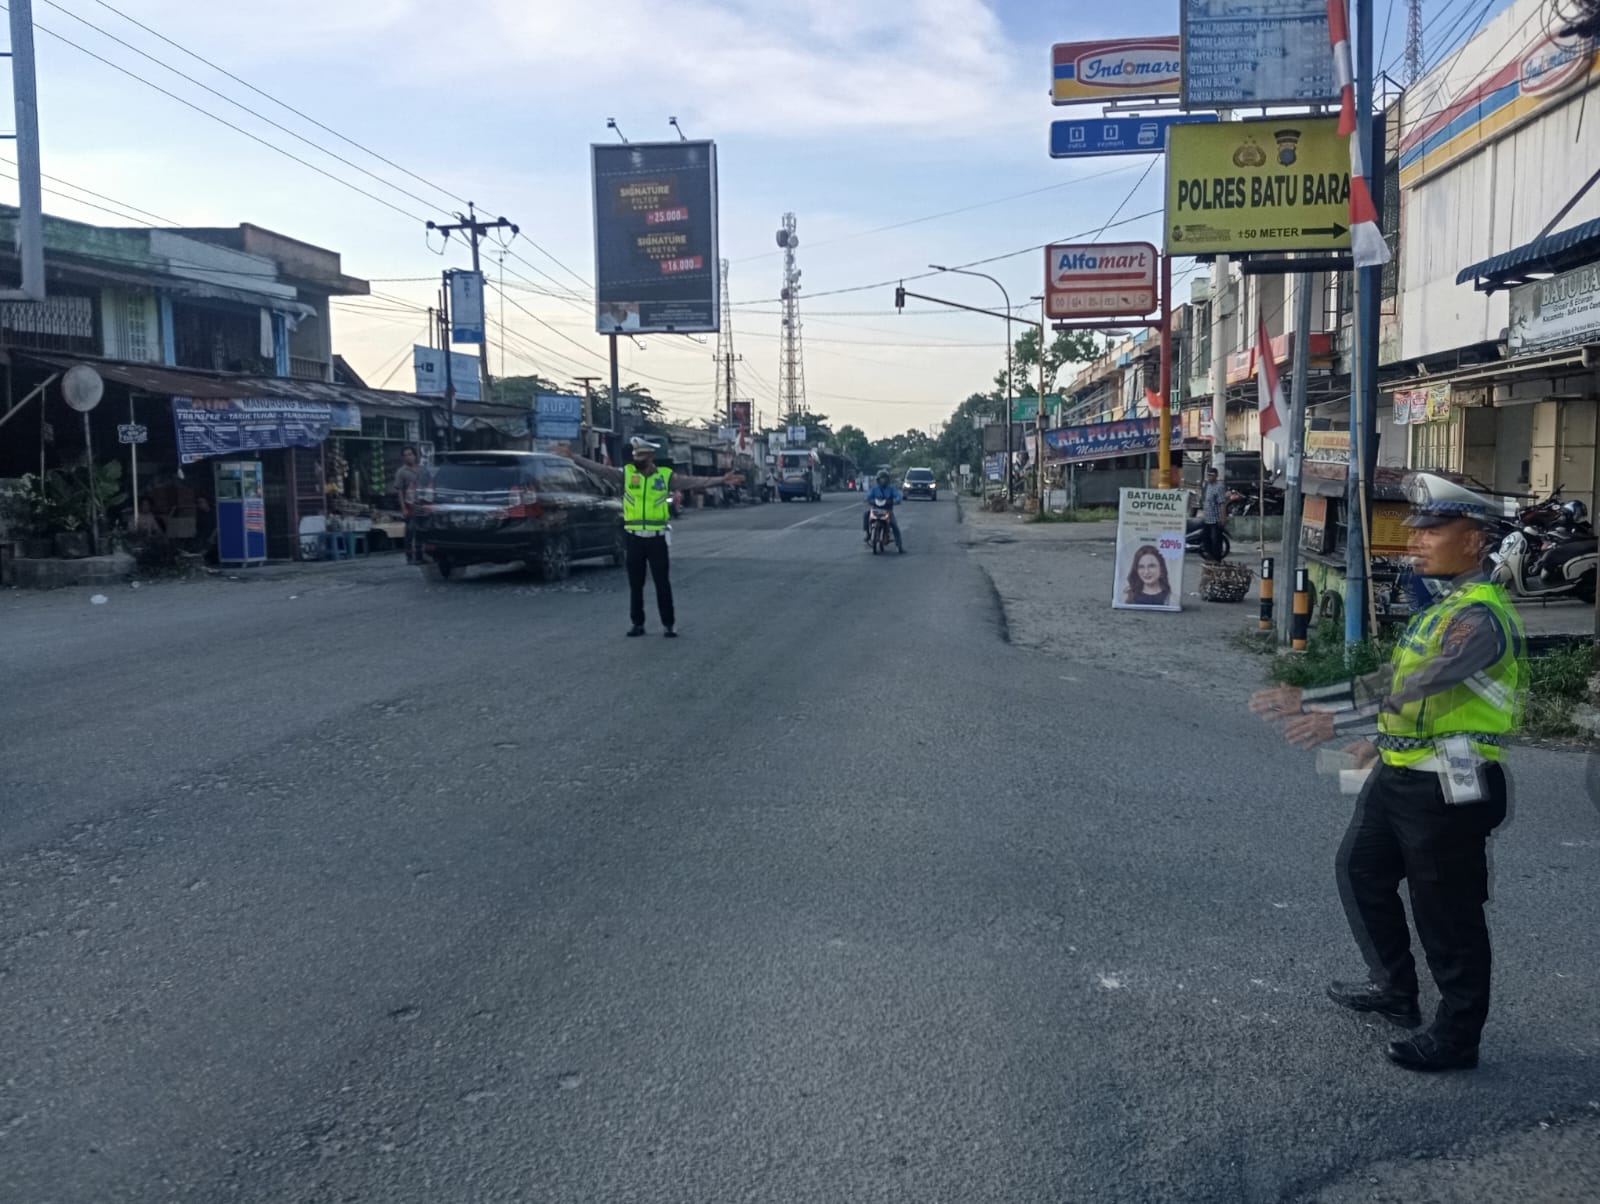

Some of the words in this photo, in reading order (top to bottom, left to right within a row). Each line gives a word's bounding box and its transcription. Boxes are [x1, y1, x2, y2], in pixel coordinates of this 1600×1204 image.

[1085, 58, 1179, 79] Indomare
[620, 184, 669, 197] SIGNATURE
[1178, 176, 1246, 211] POLRES
[1251, 174, 1298, 207] BATU
[1302, 172, 1350, 205] BARA
[1260, 228, 1299, 238] METER
[637, 235, 687, 247] SIGNATURE
[1058, 251, 1147, 271] Alfamart
[1542, 273, 1577, 306] BATU
[1580, 265, 1600, 295] BA
[1088, 421, 1140, 442] PUTRA
[1127, 490, 1182, 502] BATUBARA
[1131, 500, 1177, 511] OPTICAL
[1159, 538, 1182, 550] 20%
